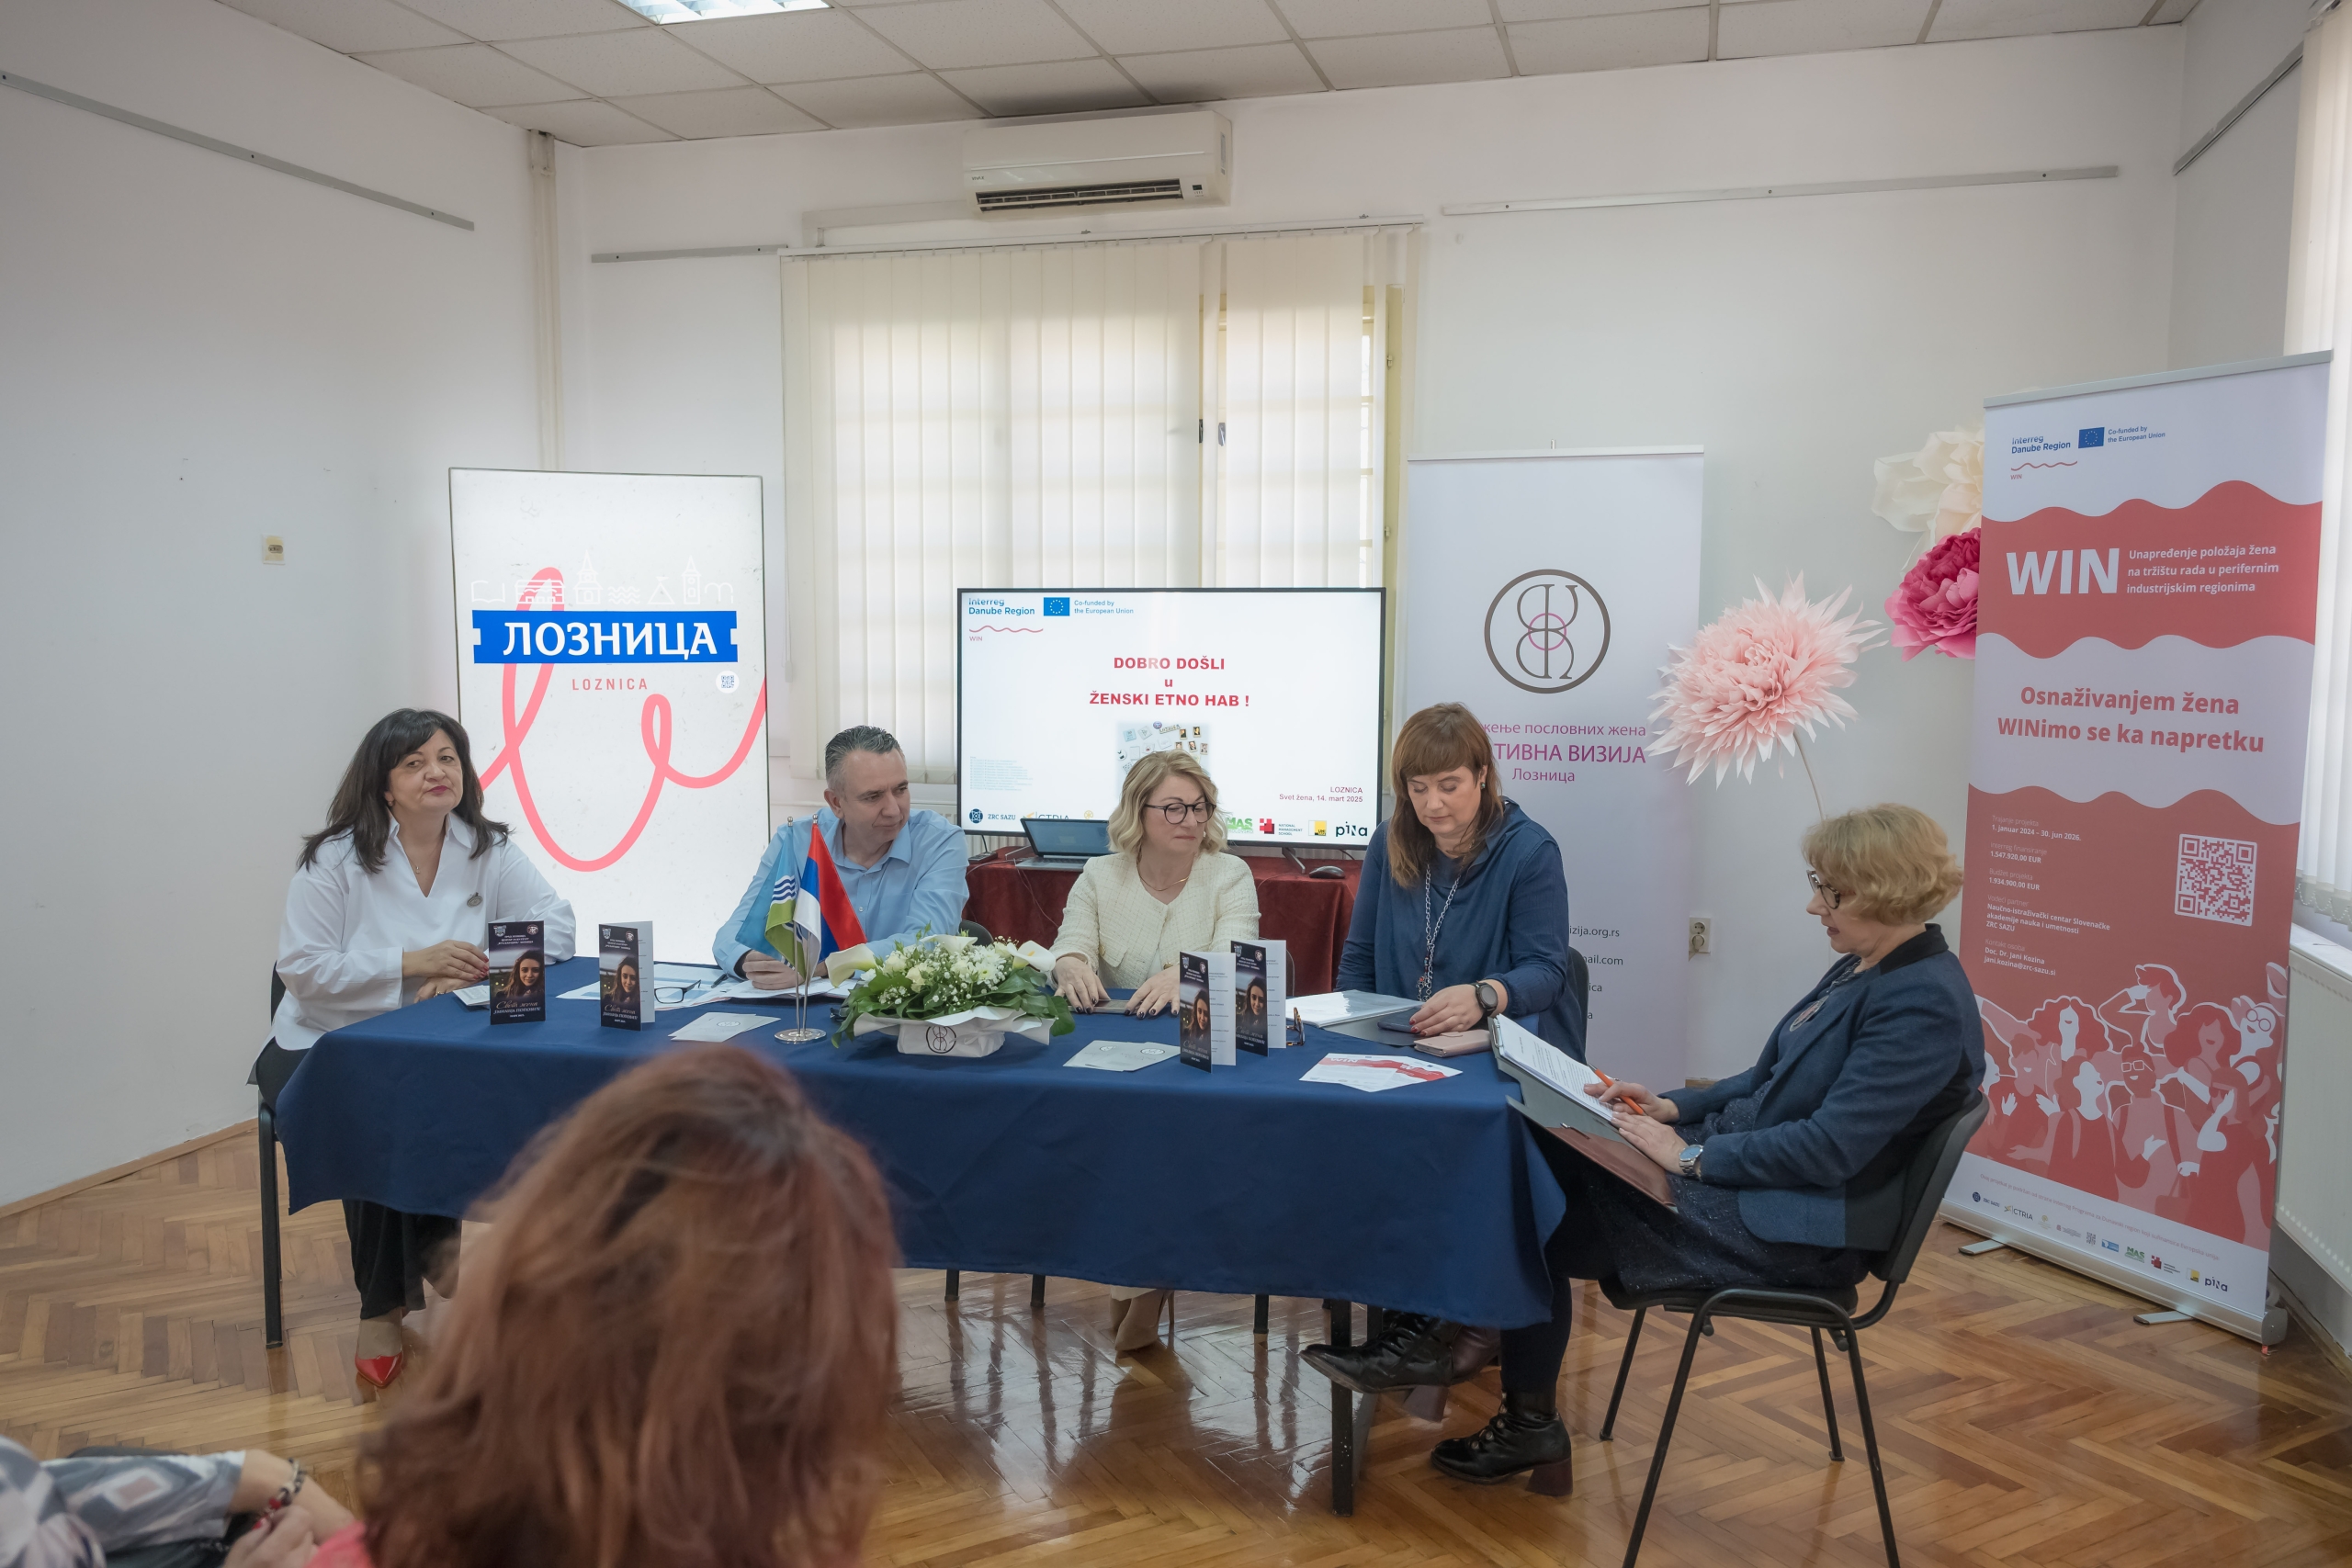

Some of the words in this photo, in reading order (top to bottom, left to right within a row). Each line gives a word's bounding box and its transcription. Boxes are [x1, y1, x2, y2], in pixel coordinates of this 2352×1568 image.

[2109, 426, 2138, 434] Co-funded
[2012, 435, 2043, 445] Interreg
[2012, 444, 2041, 454] Danube
[2043, 442, 2071, 451] Region
[2129, 548, 2197, 560] Unapređenje
[2200, 546, 2245, 559] položaja
[2249, 545, 2276, 555] žena
[2007, 548, 2120, 594] WIN
[2128, 567, 2140, 576] na
[2143, 565, 2177, 576] tržištu
[2180, 564, 2205, 575] rada
[2209, 566, 2215, 574] u
[2219, 563, 2278, 576] perifernim
[2127, 583, 2196, 595] industrijskim
[2199, 582, 2255, 594] regionima
[1005, 607, 1035, 615] Region
[503, 622, 717, 660] ЛОЗНИЦА
[1114, 658, 1170, 669] DOBRO
[1177, 656, 1224, 670] DOŠLI
[572, 679, 648, 691] LOZNICA
[1090, 691, 1148, 705] ŽENSKI
[1155, 694, 1199, 705] ETNO
[1205, 695, 1239, 706] HAB
[1246, 695, 1249, 706] !
[2021, 687, 2175, 715] Osnaživanjem
[2182, 692, 2239, 714] žena
[1525, 725, 1604, 736] пословних
[1609, 726, 1645, 736] жена
[1998, 717, 2081, 739] WINimo
[2087, 727, 2110, 741] se
[2118, 724, 2143, 744] ka
[2151, 730, 2263, 752] napretku
[1569, 746, 1645, 763] ВИЗИЈА
[1512, 768, 1575, 784] Лозница
[1992, 816, 2014, 824] Trajanje
[1997, 825, 2018, 833] januar
[1991, 842, 2012, 852] Interreg
[2014, 845, 2047, 856] finansiranje
[1990, 851, 2027, 862] 1.547.920,00
[1989, 868, 2008, 876] Budžet
[2010, 872, 2032, 881] projekta
[1989, 877, 2025, 888] 1.934.900,00
[1988, 895, 2006, 903] Vodeći
[2007, 898, 2029, 907] partner
[1987, 904, 2049, 919] Naučno-istraživački
[2051, 915, 2071, 923] centar
[2073, 919, 2109, 931] Slovenačke
[1987, 913, 2018, 924] akademije
[2020, 919, 2040, 927] nauka
[2045, 924, 2078, 933] umetnosti
[1985, 939, 2007, 948] Kontakt
[1985, 947, 1997, 955] Doc.
[2009, 952, 2021, 960] Jani
[2023, 953, 2044, 964] Kozina
[1984, 956, 2055, 976] jani.kozina@zrc-sazu.si
[2014, 1209, 2033, 1221] CTRIA
[2126, 1247, 2144, 1258] MAS
